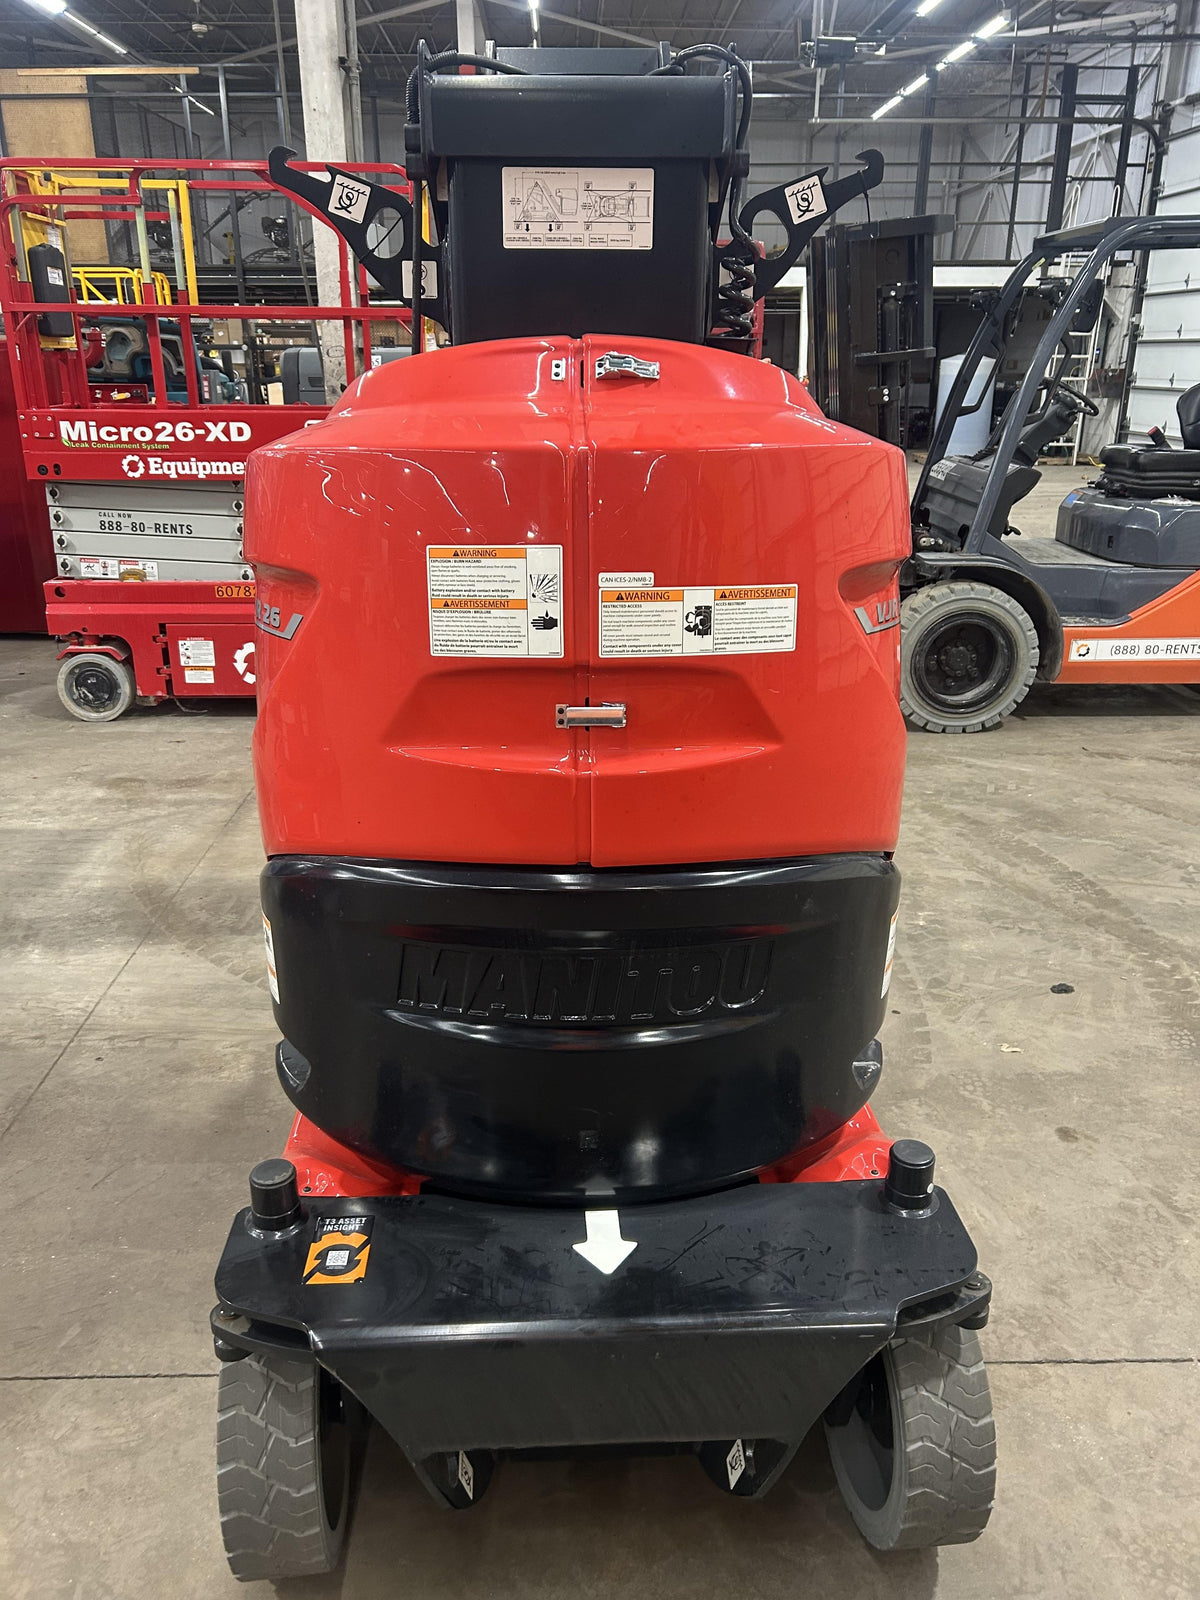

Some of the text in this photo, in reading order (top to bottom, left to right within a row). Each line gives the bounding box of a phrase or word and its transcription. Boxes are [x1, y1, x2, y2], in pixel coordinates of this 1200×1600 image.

[91, 441, 140, 449] Containment
[141, 442, 170, 450] System
[147, 457, 247, 478] Equipme
[99, 519, 193, 535] 888-80-RENTS
[460, 549, 497, 557] WARNING
[624, 592, 670, 600] WARNING
[727, 588, 792, 598] AVERTISSEMENT
[263, 603, 281, 628] 26
[1110, 644, 1140, 656] (888)
[396, 941, 775, 1021] MANITOU
